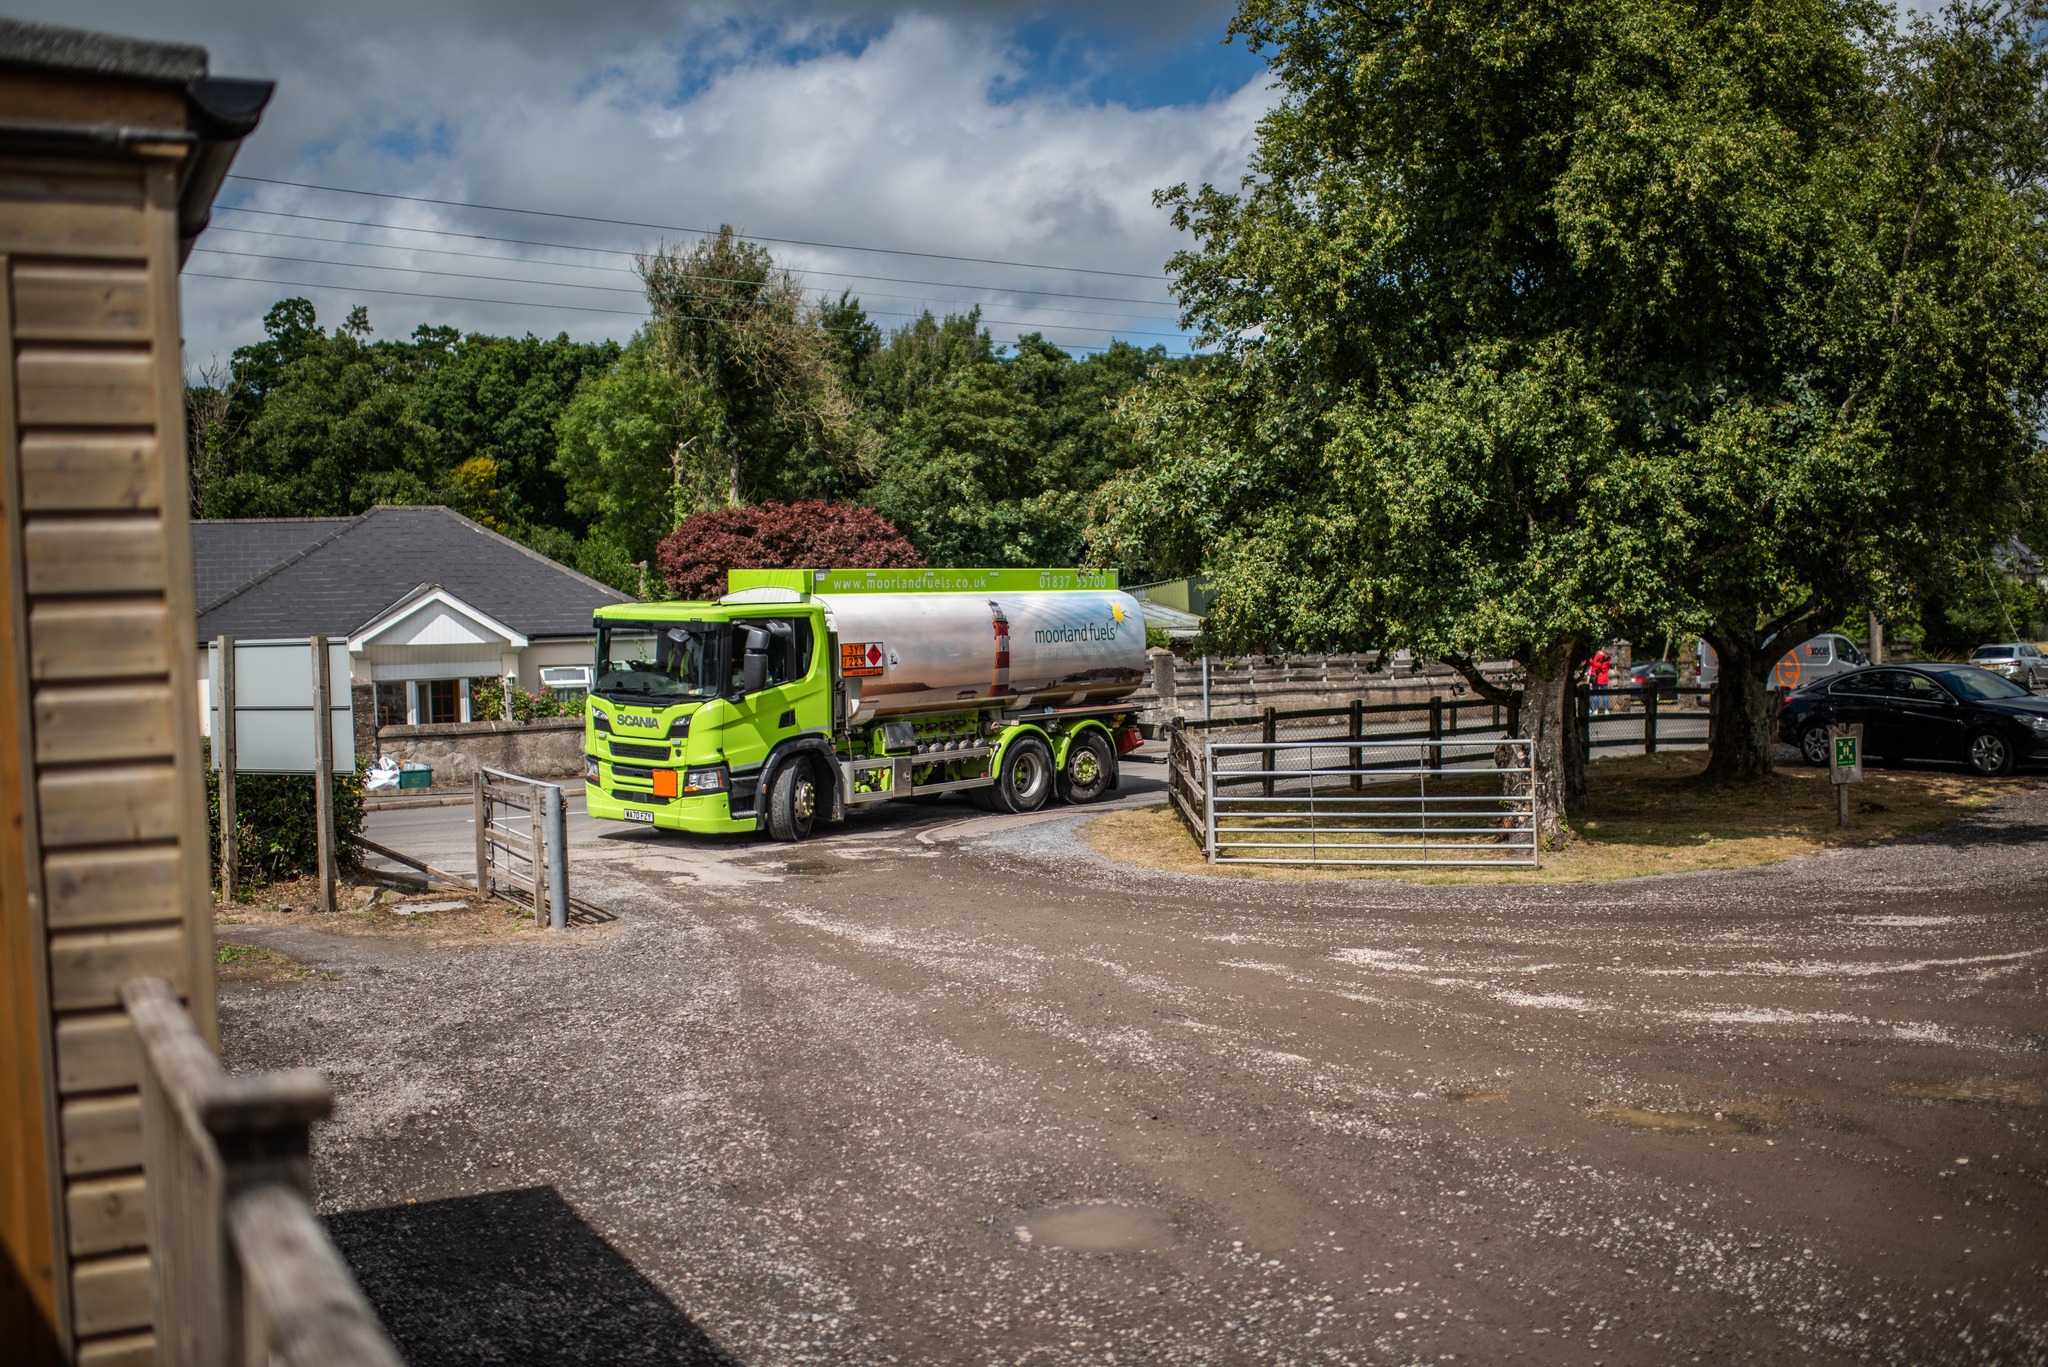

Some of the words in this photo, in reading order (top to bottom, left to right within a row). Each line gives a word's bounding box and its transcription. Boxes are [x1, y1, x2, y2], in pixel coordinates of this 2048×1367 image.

[833, 576, 986, 589] www.moorlandfuels.co.uk
[1039, 575, 1071, 588] 01837
[1076, 576, 1106, 588] 55700
[1034, 624, 1088, 643] moorland
[1089, 622, 1115, 641] fuels
[848, 646, 859, 655] 3Y
[617, 714, 660, 729] SCANIA
[640, 812, 652, 820] FZY
